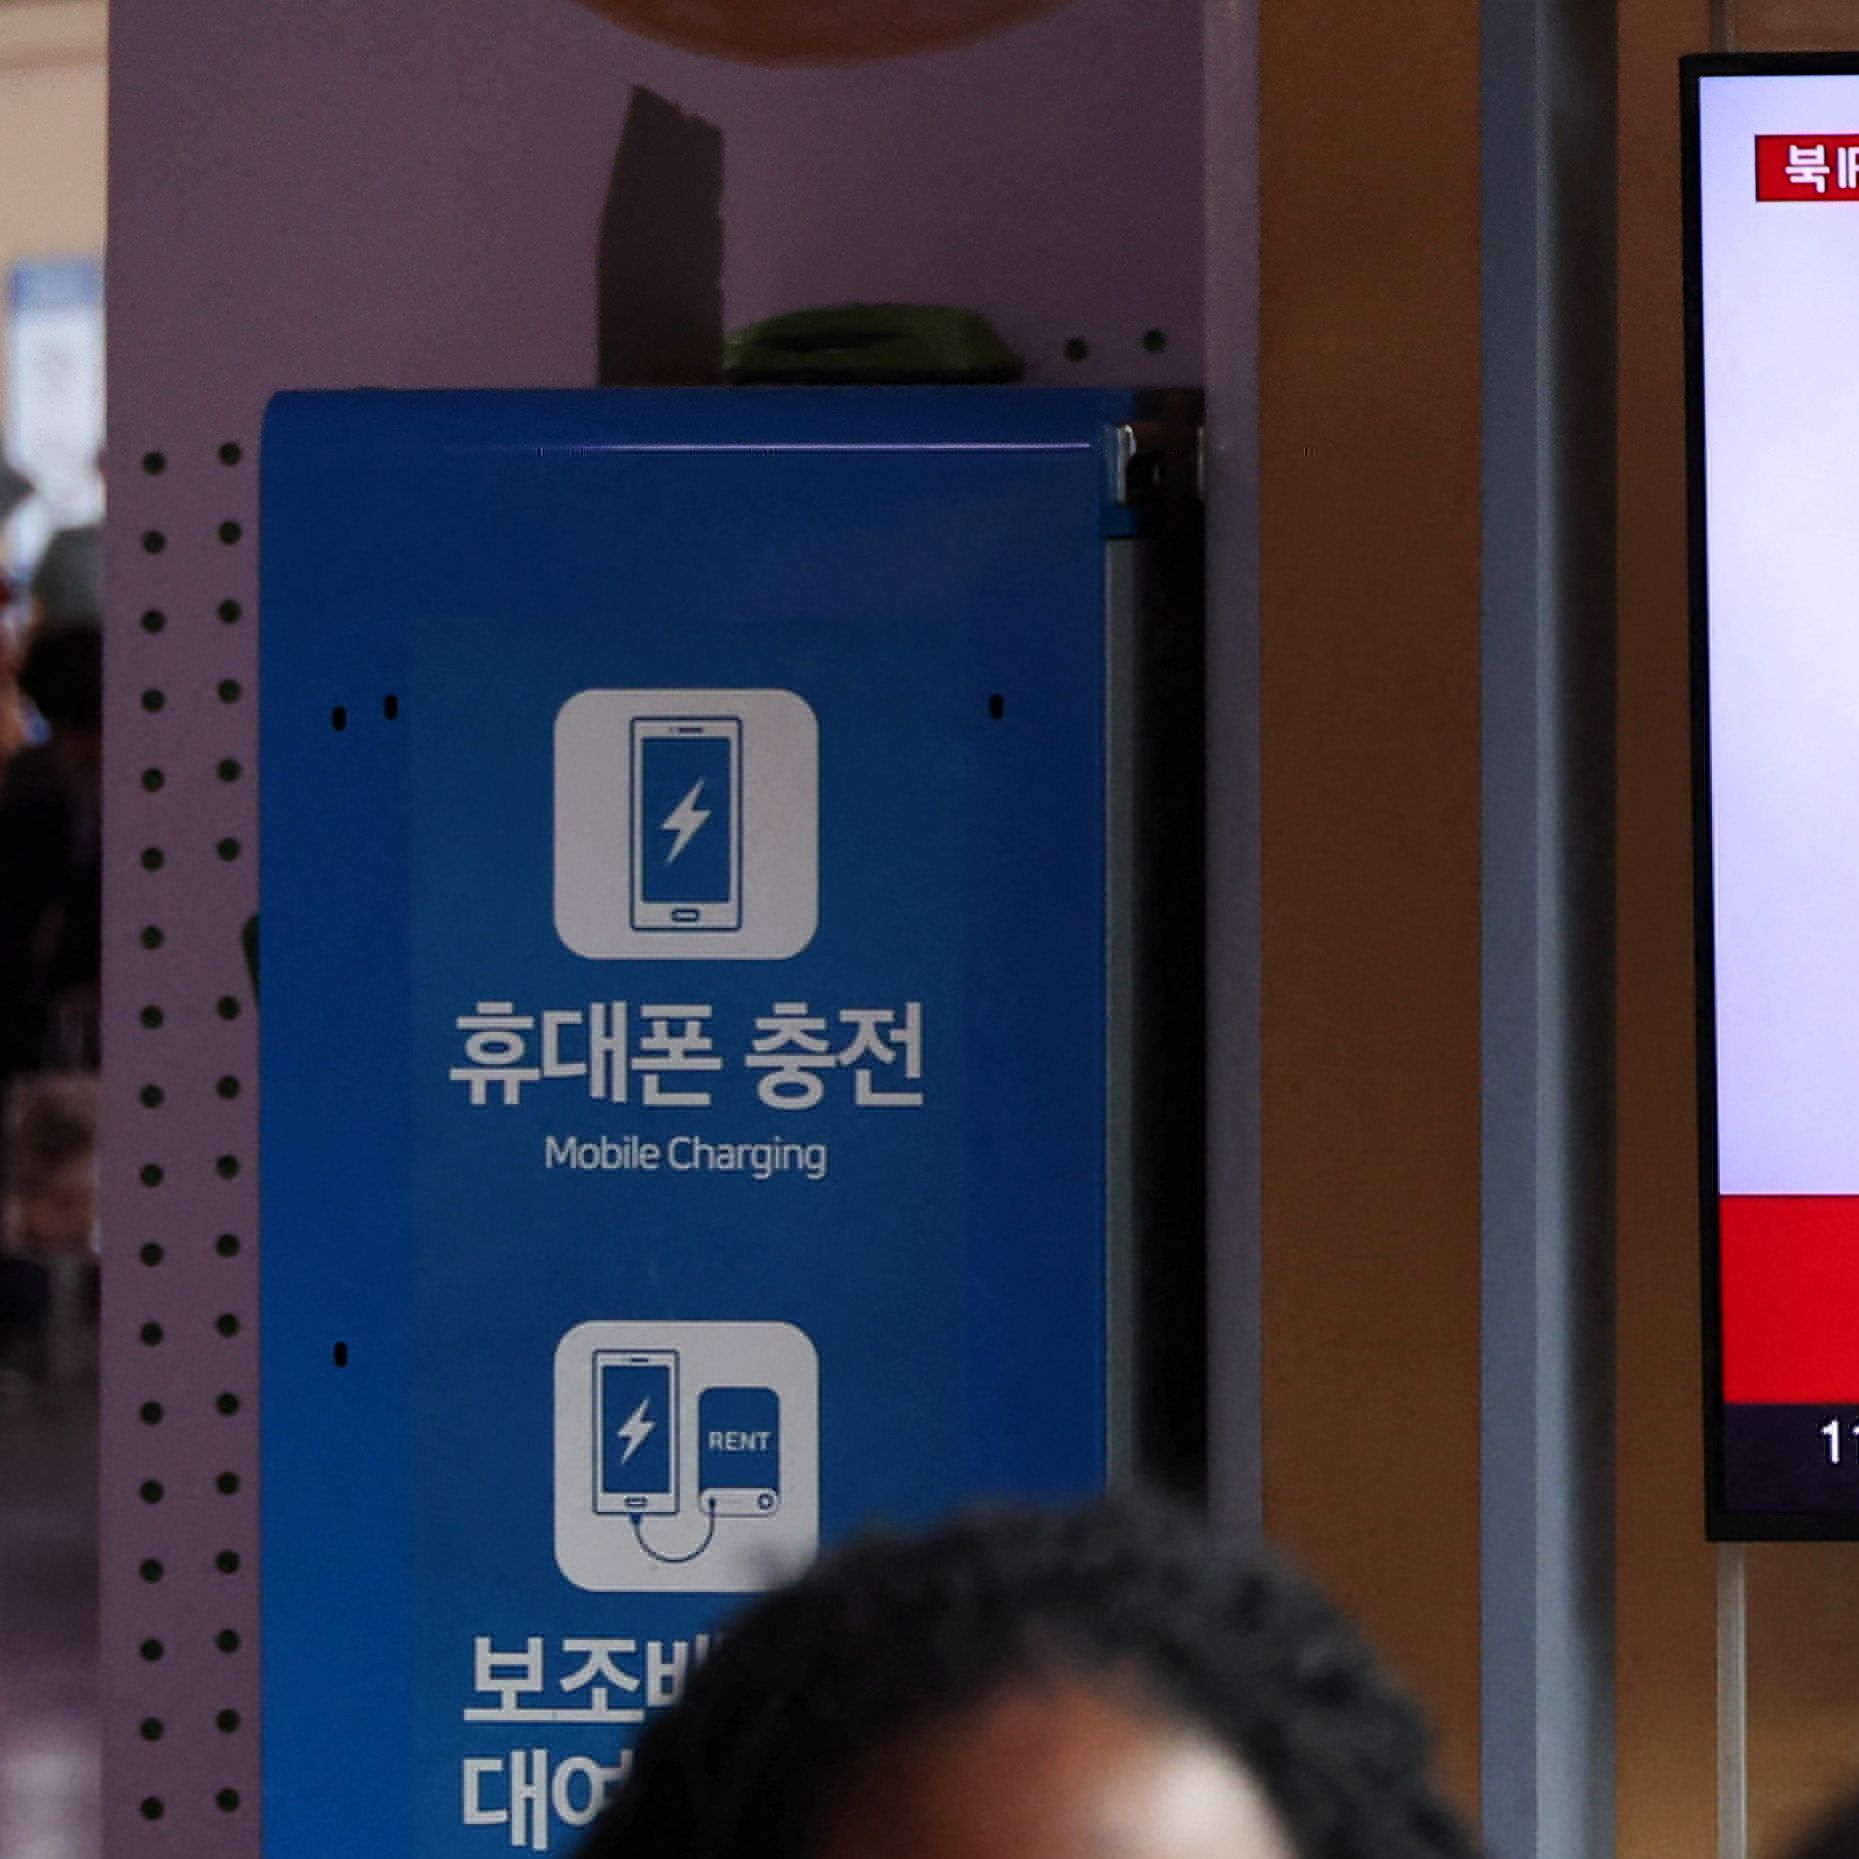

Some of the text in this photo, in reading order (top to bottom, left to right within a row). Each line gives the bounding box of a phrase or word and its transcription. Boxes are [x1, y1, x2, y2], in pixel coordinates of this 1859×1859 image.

[1784, 144, 1830, 193] 북
[449, 1000, 924, 1110] 휴대폰 충전
[545, 1136, 828, 1180] Mobile Charging
[708, 1431, 772, 1451] RENT
